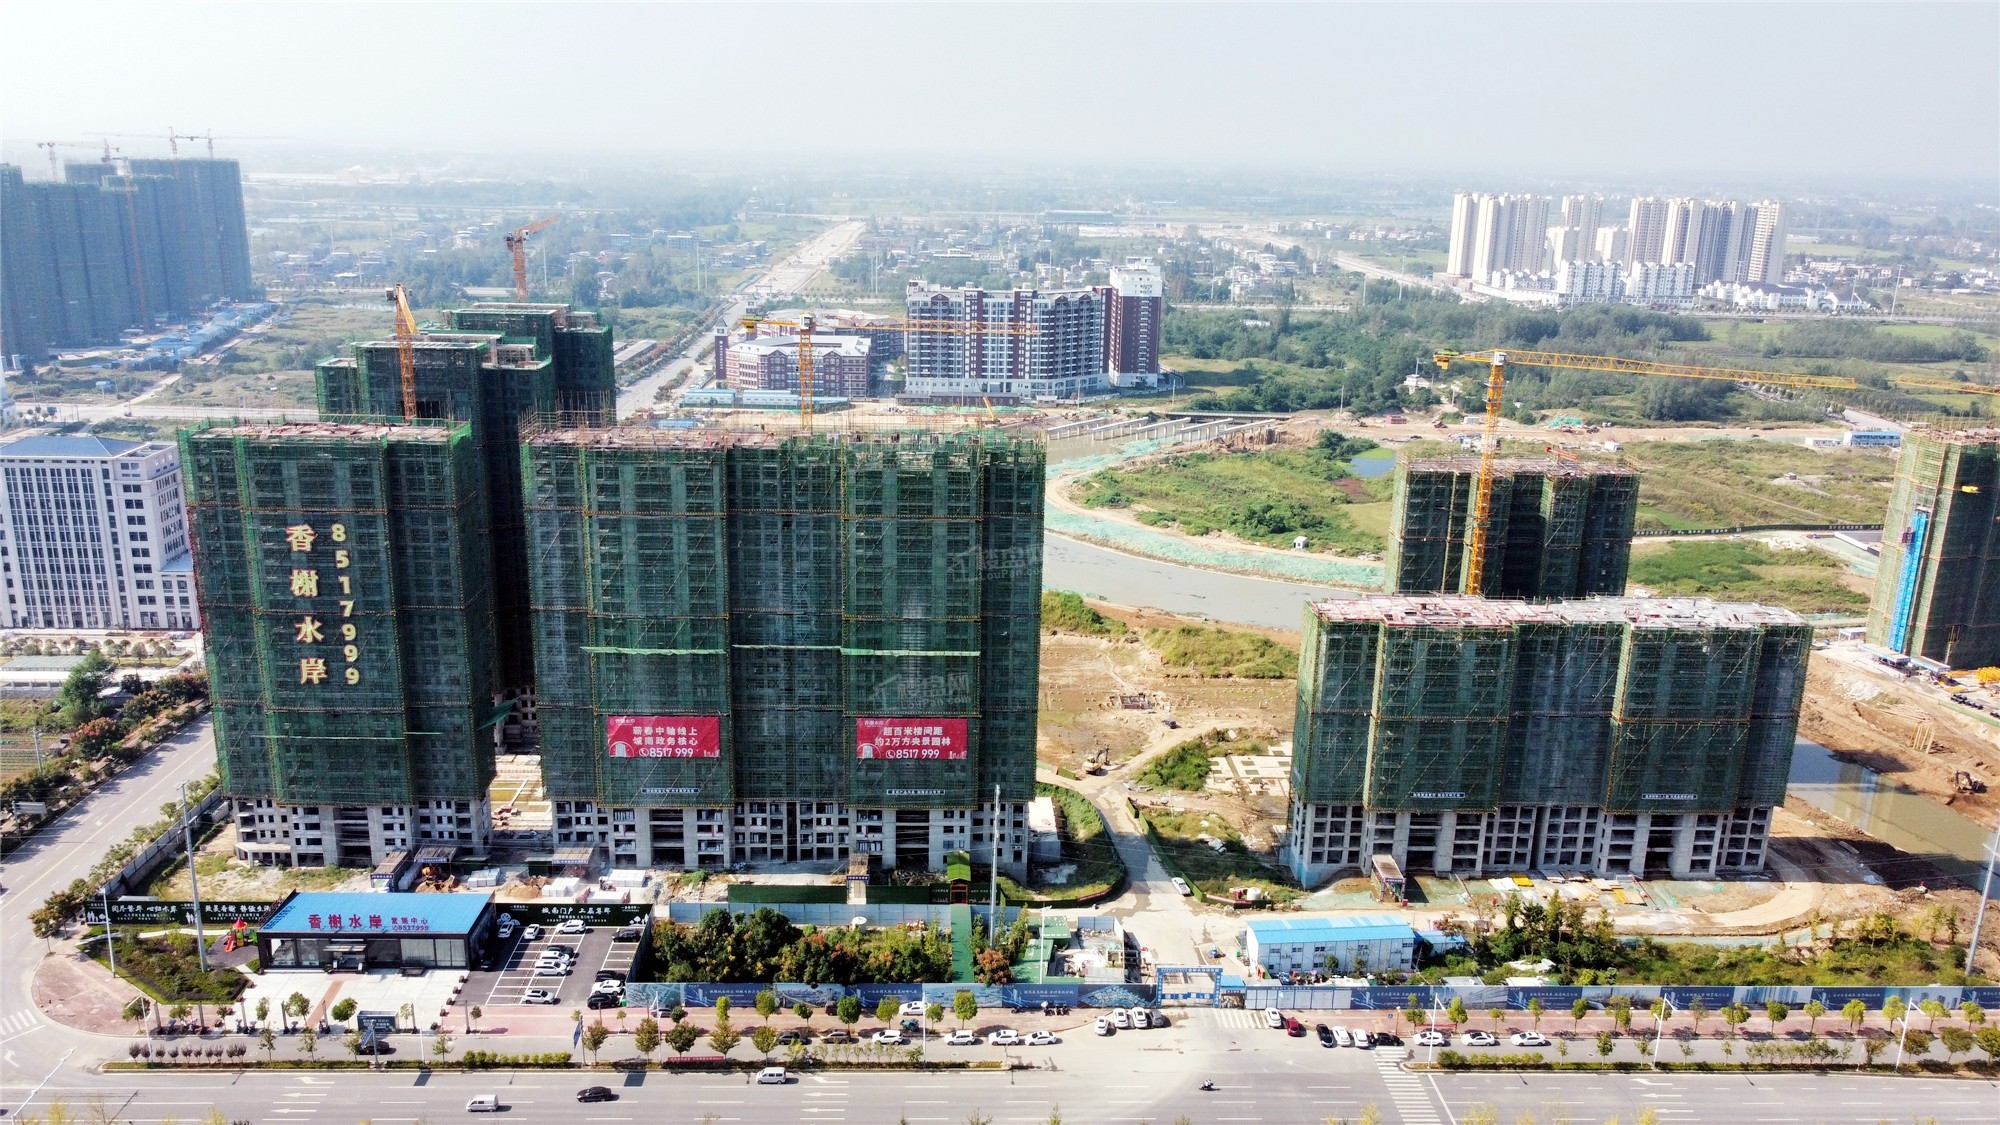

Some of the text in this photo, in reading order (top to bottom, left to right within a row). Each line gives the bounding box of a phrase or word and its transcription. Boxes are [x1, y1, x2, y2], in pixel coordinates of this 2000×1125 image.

[286, 524, 329, 685] 香榭水岸
[330, 524, 361, 685] 8517999
[883, 726, 943, 736] 超百米楼间距
[632, 737, 698, 746] 城南政务核心
[874, 737, 951, 746] 约2万方央景园林
[649, 747, 694, 757] 8517 999
[895, 749, 940, 759] 8517 999
[308, 913, 383, 929] 香榭水岸
